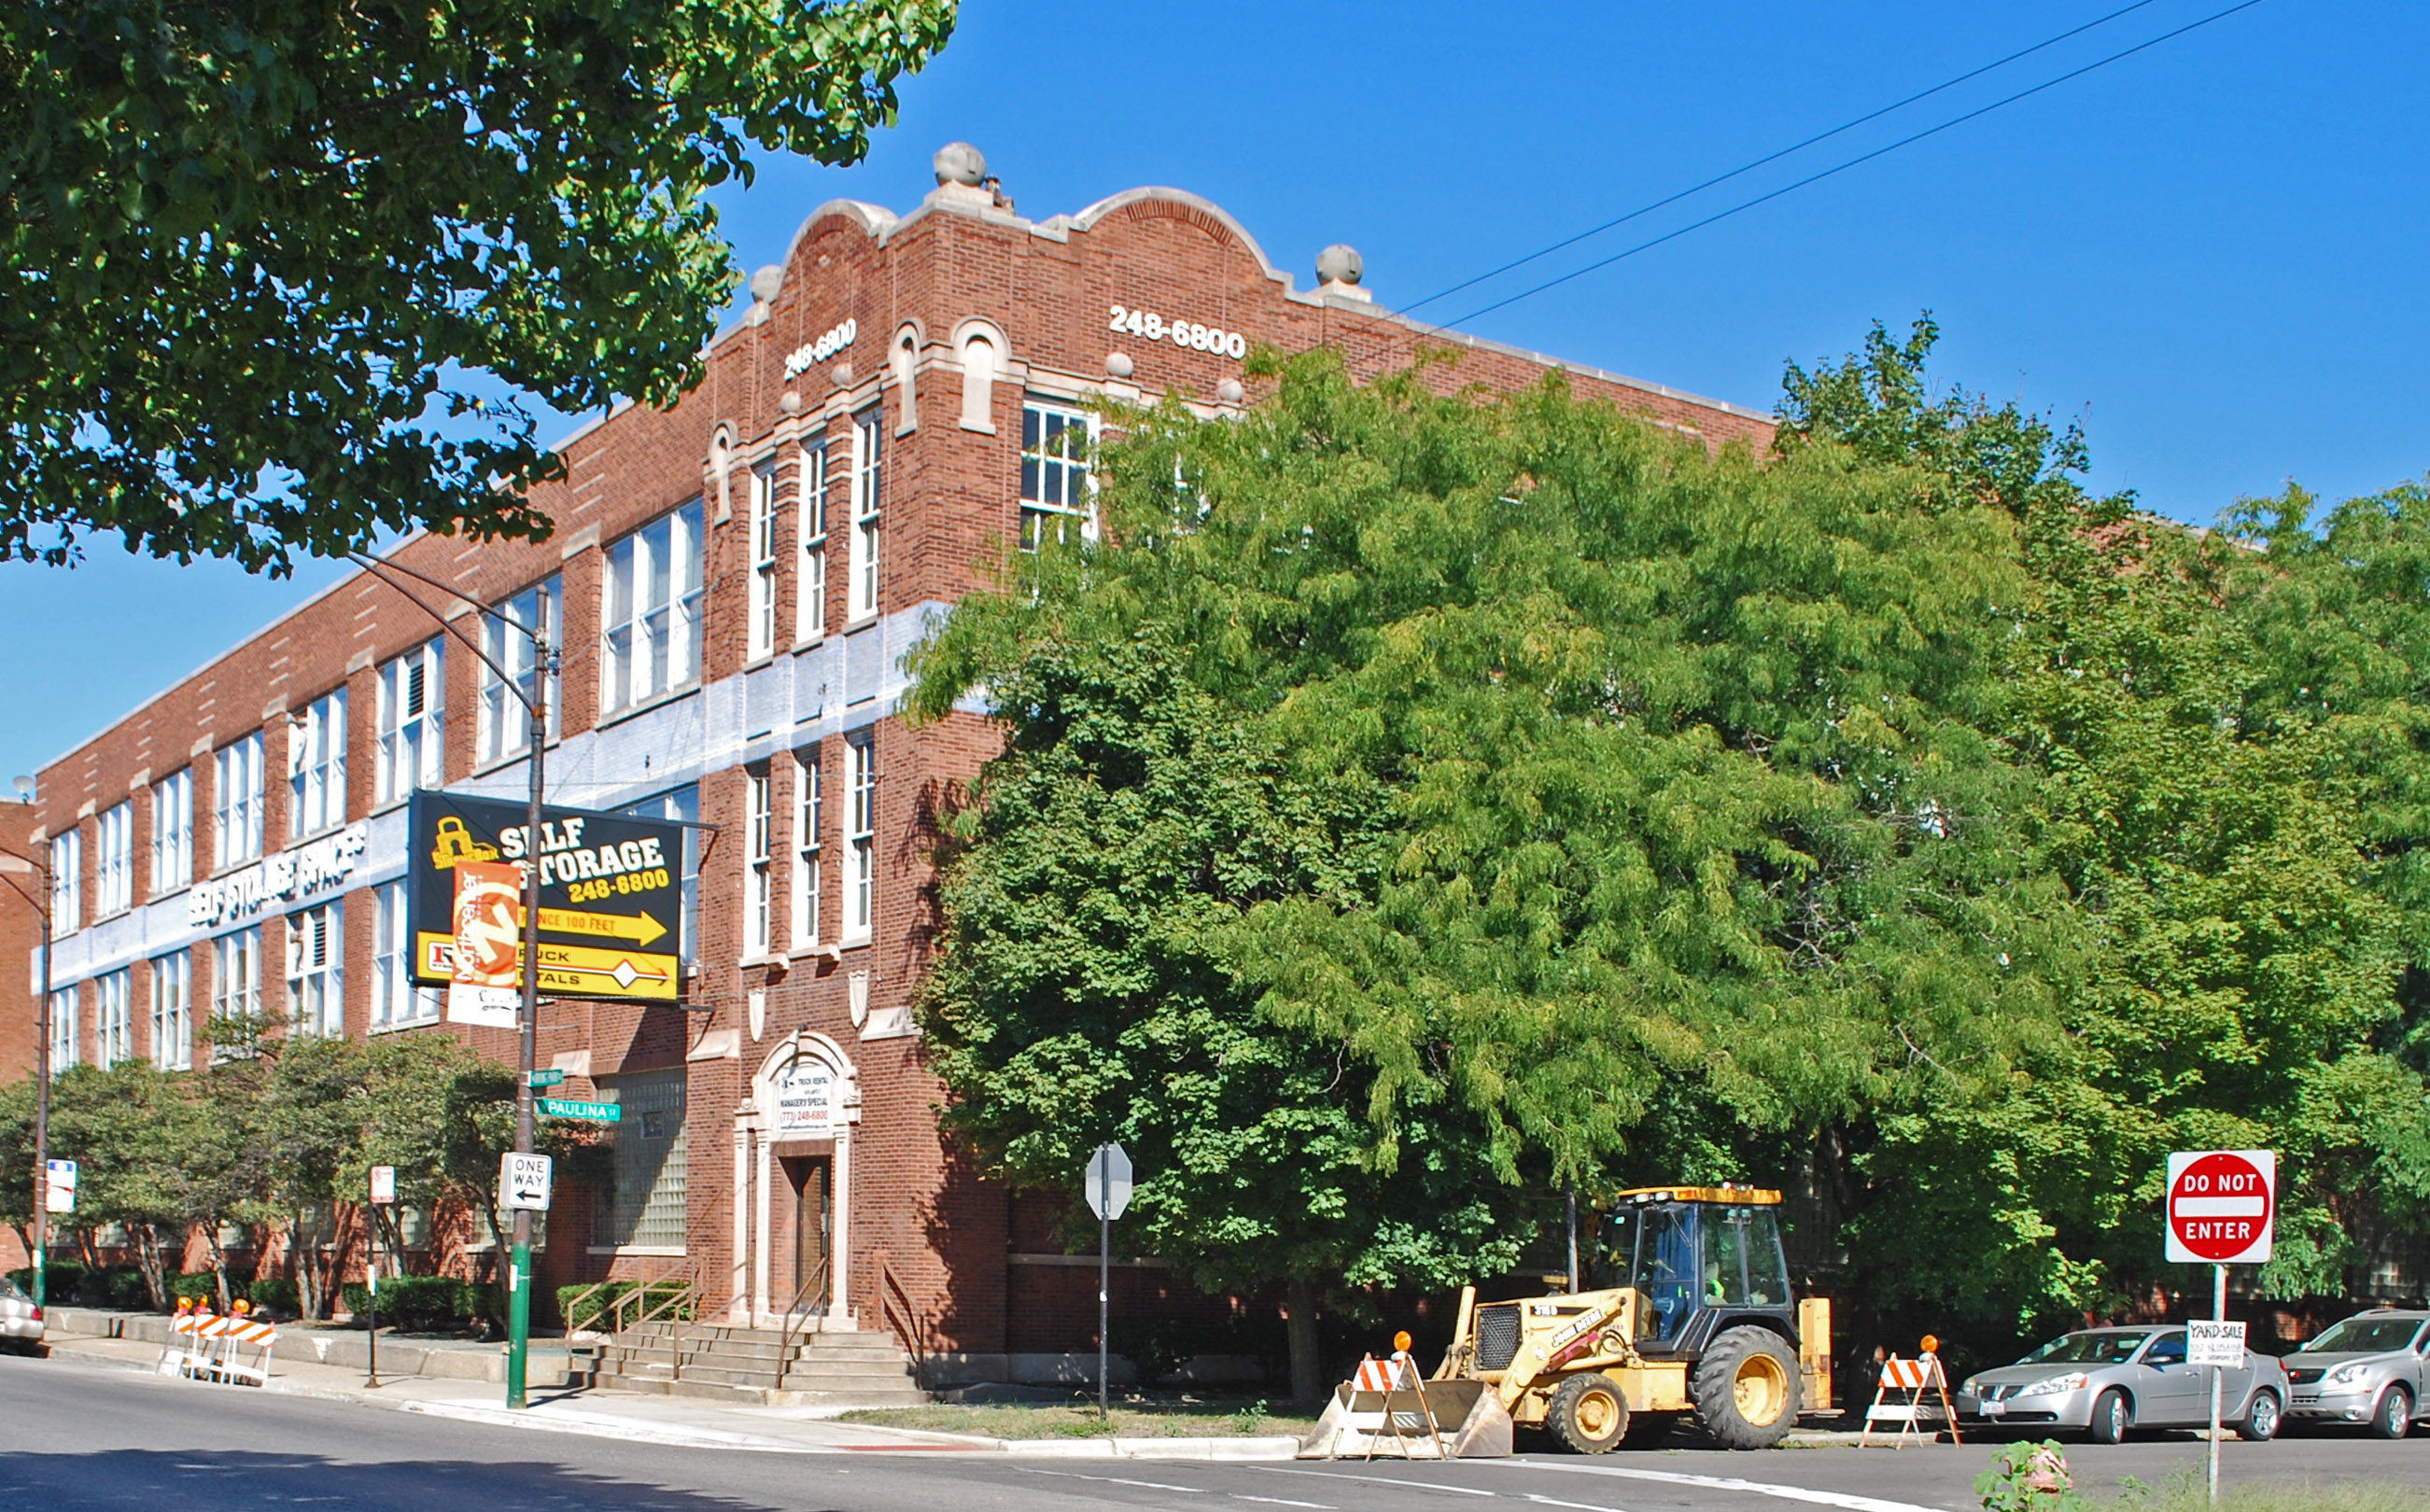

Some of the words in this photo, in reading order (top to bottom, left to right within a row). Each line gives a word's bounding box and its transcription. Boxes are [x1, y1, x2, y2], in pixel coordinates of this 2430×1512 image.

[1109, 304, 1246, 359] 248-6800
[784, 317, 857, 382] 248-6800
[568, 868, 670, 903] 248-6800
[566, 916, 586, 929] 100
[589, 918, 616, 931] FEET
[548, 1101, 607, 1118] PAULINA
[808, 1098, 828, 1108] SPECIAL
[515, 1159, 544, 1173] ONE
[514, 1173, 544, 1187] WAY
[2184, 1174, 2210, 1192] DO
[2218, 1173, 2257, 1191] NOT
[2185, 1222, 2251, 1239] ENTER
[1552, 1325, 1577, 1347] JOHN
[1574, 1309, 1602, 1333] DEERE
